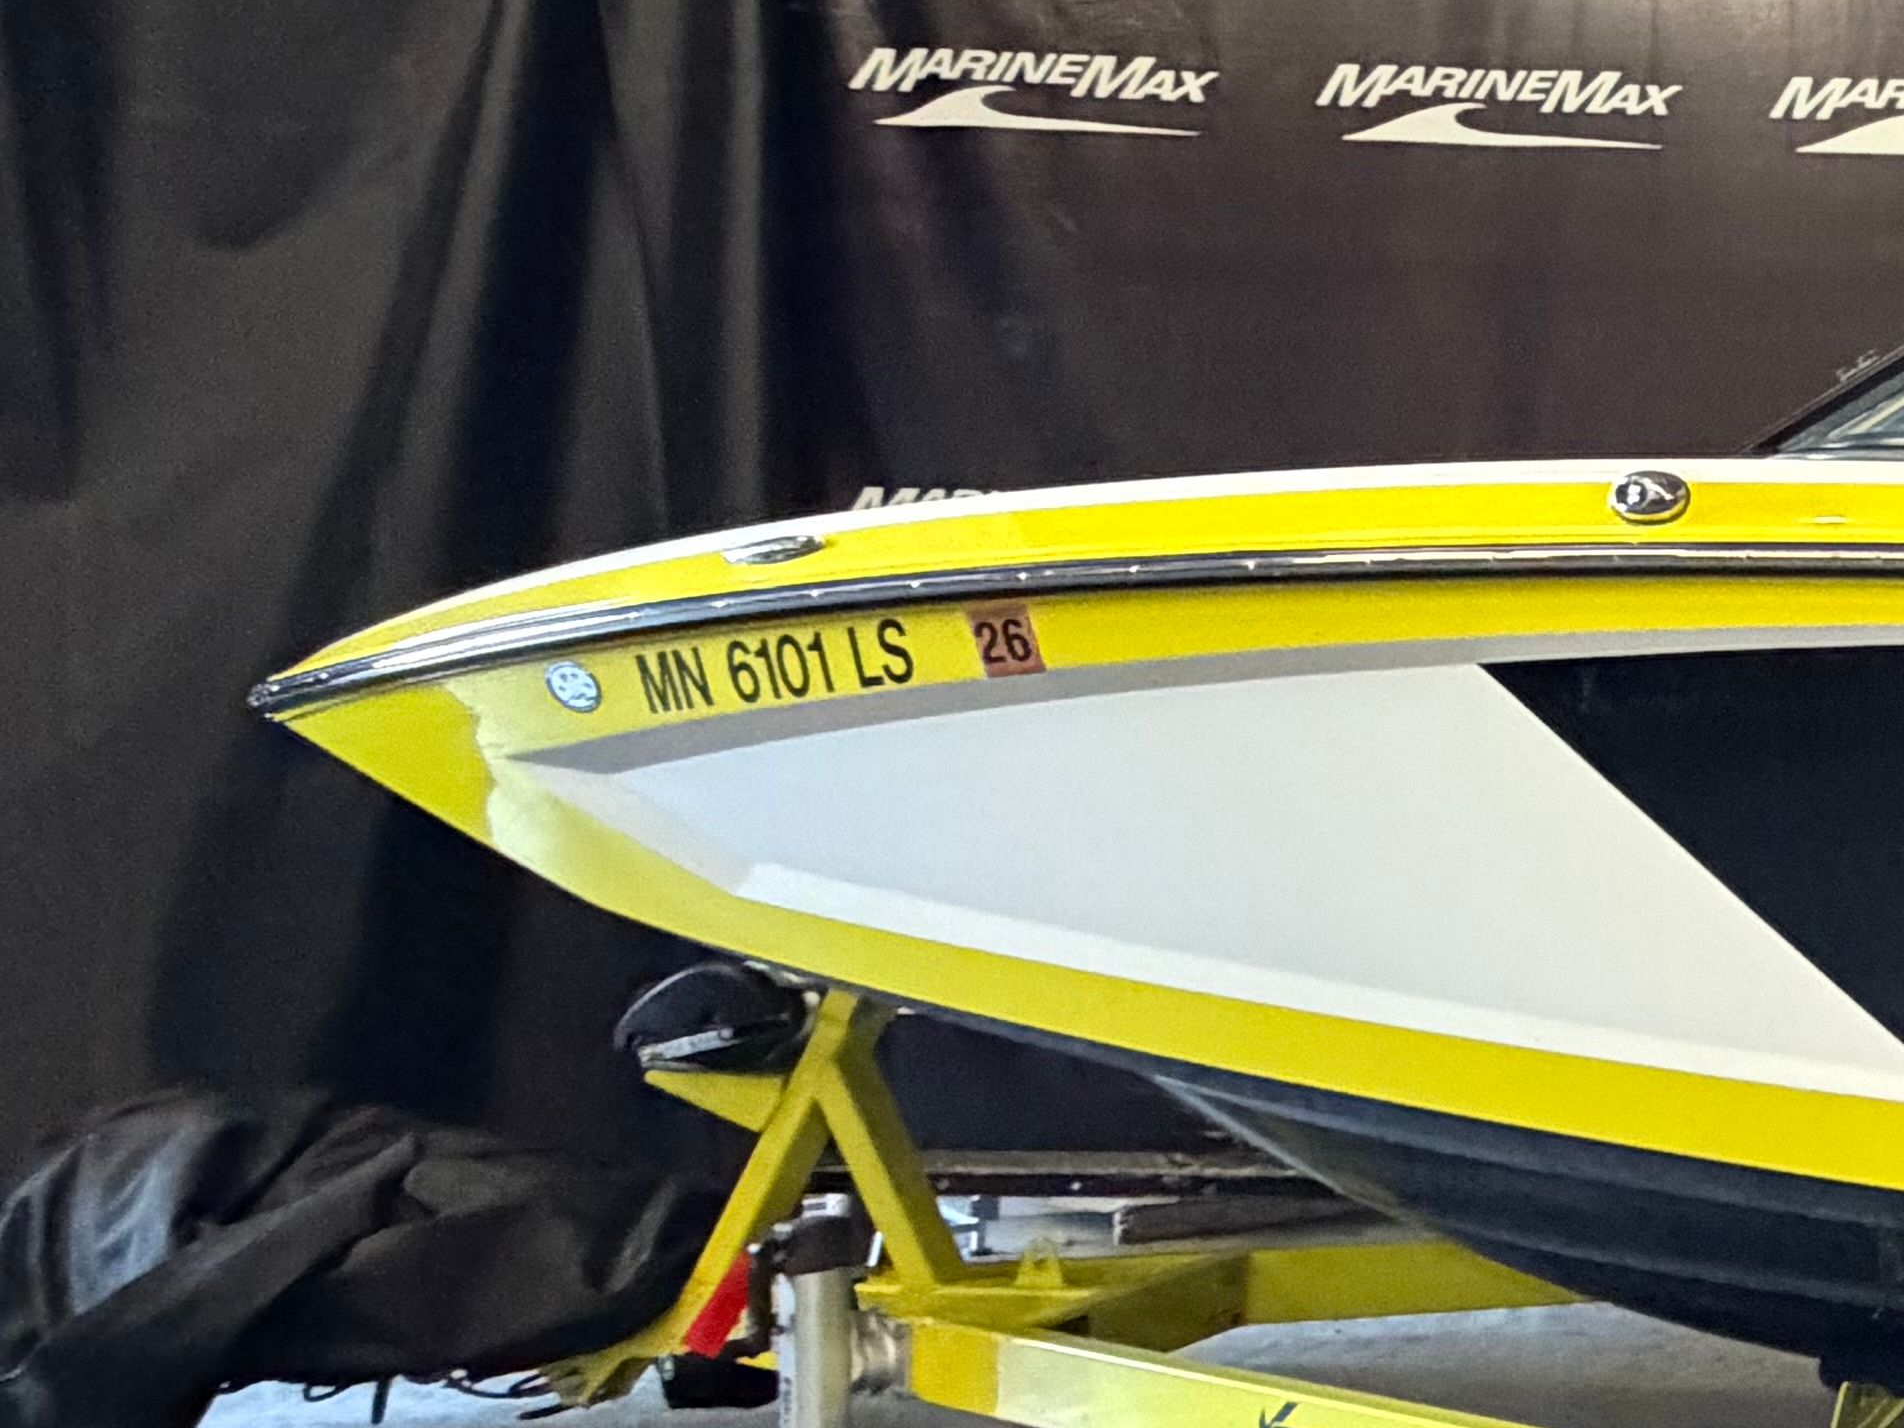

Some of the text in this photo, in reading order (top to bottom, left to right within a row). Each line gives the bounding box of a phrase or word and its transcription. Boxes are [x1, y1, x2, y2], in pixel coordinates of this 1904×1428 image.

[634, 619, 914, 714] MN 6101 LS
[974, 619, 1032, 665] 26
